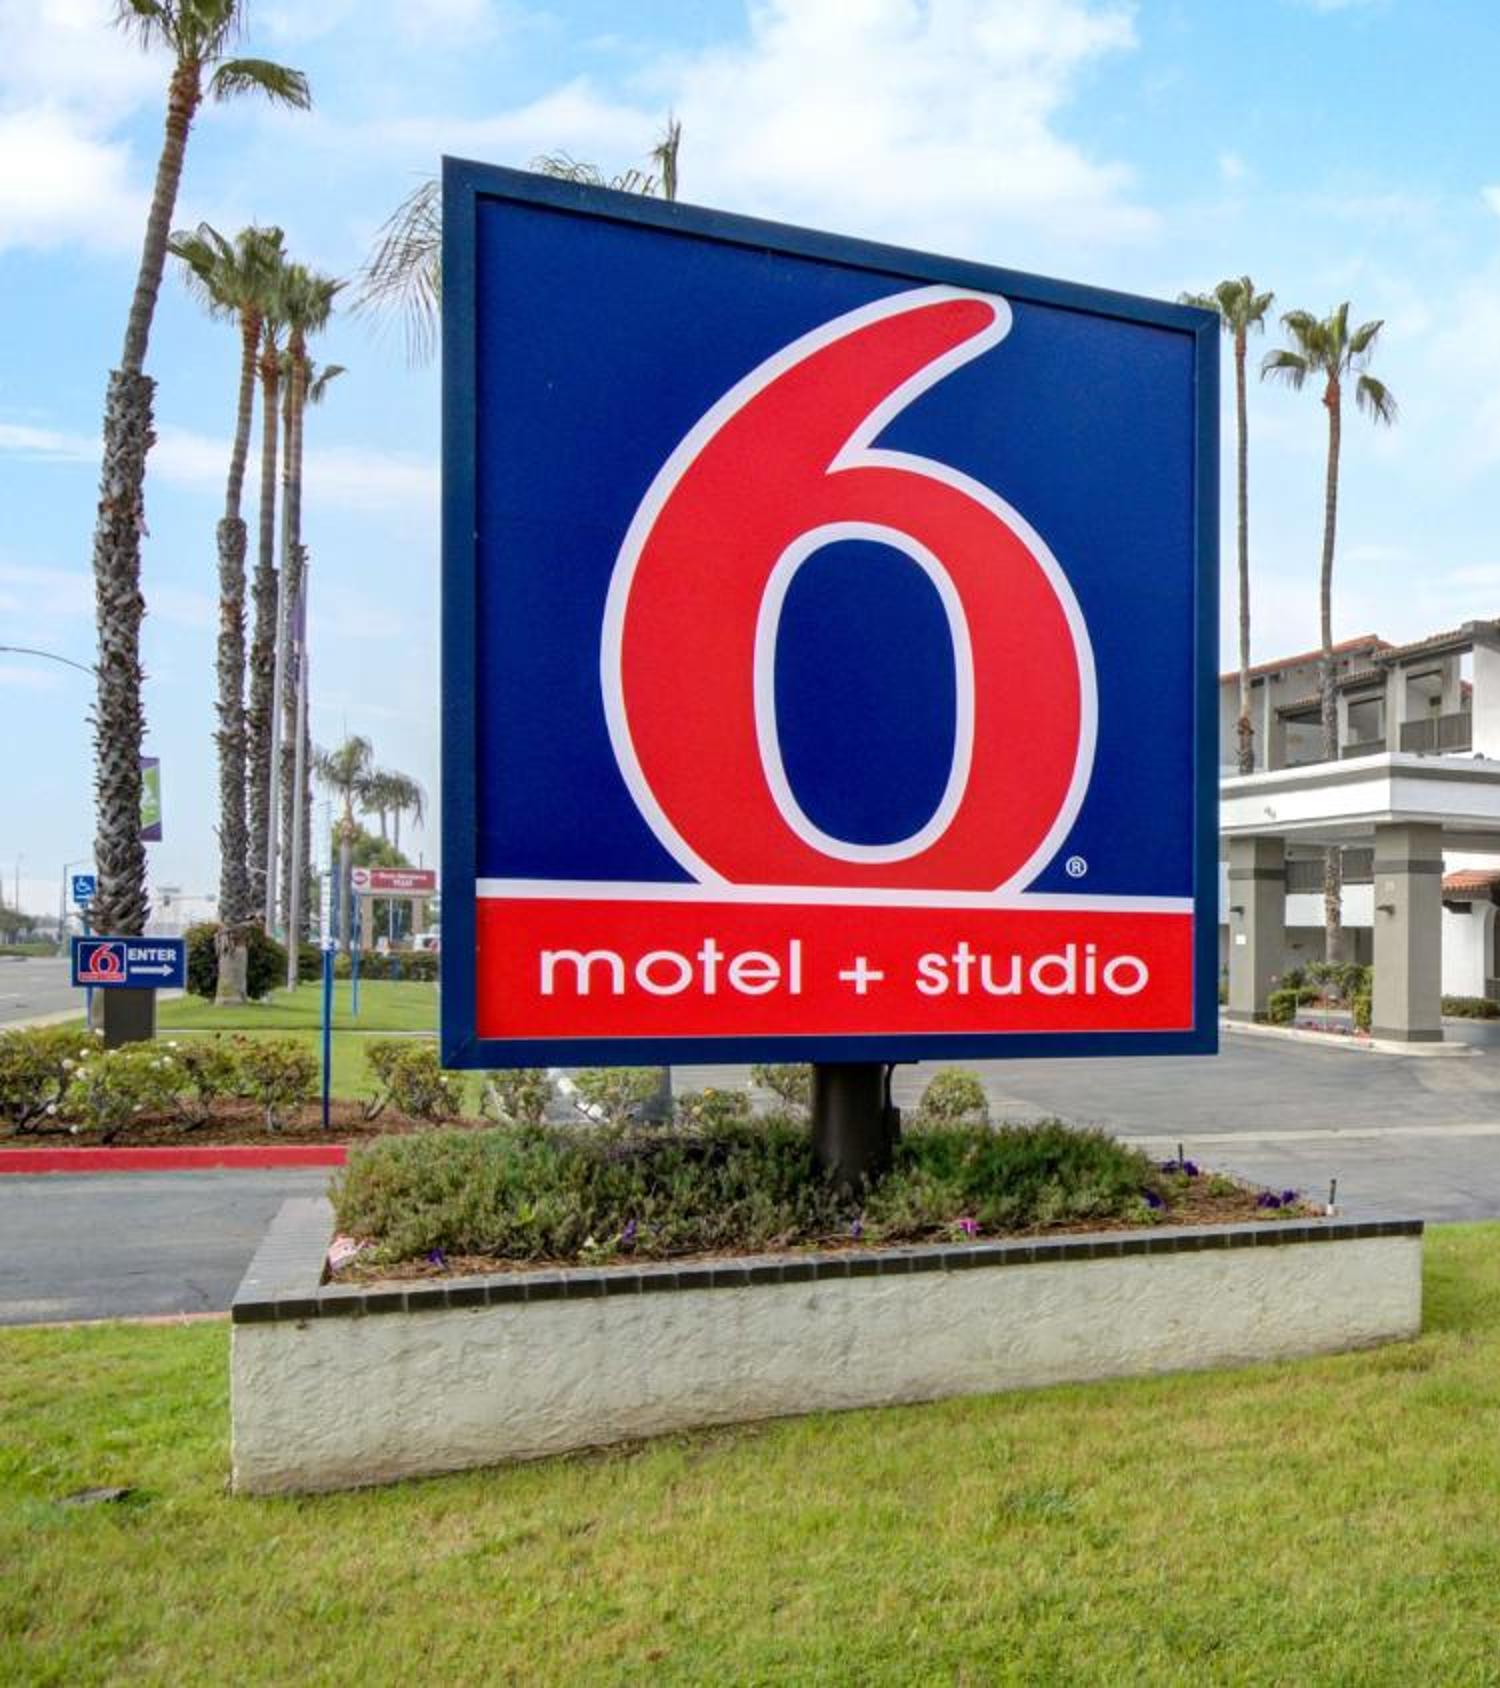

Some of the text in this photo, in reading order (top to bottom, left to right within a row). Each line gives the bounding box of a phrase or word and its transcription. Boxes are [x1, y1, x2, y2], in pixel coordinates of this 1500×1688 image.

[600, 284, 1099, 893] 6
[127, 947, 177, 962] ENTER
[540, 937, 802, 996] motel
[915, 941, 1150, 996] studio
